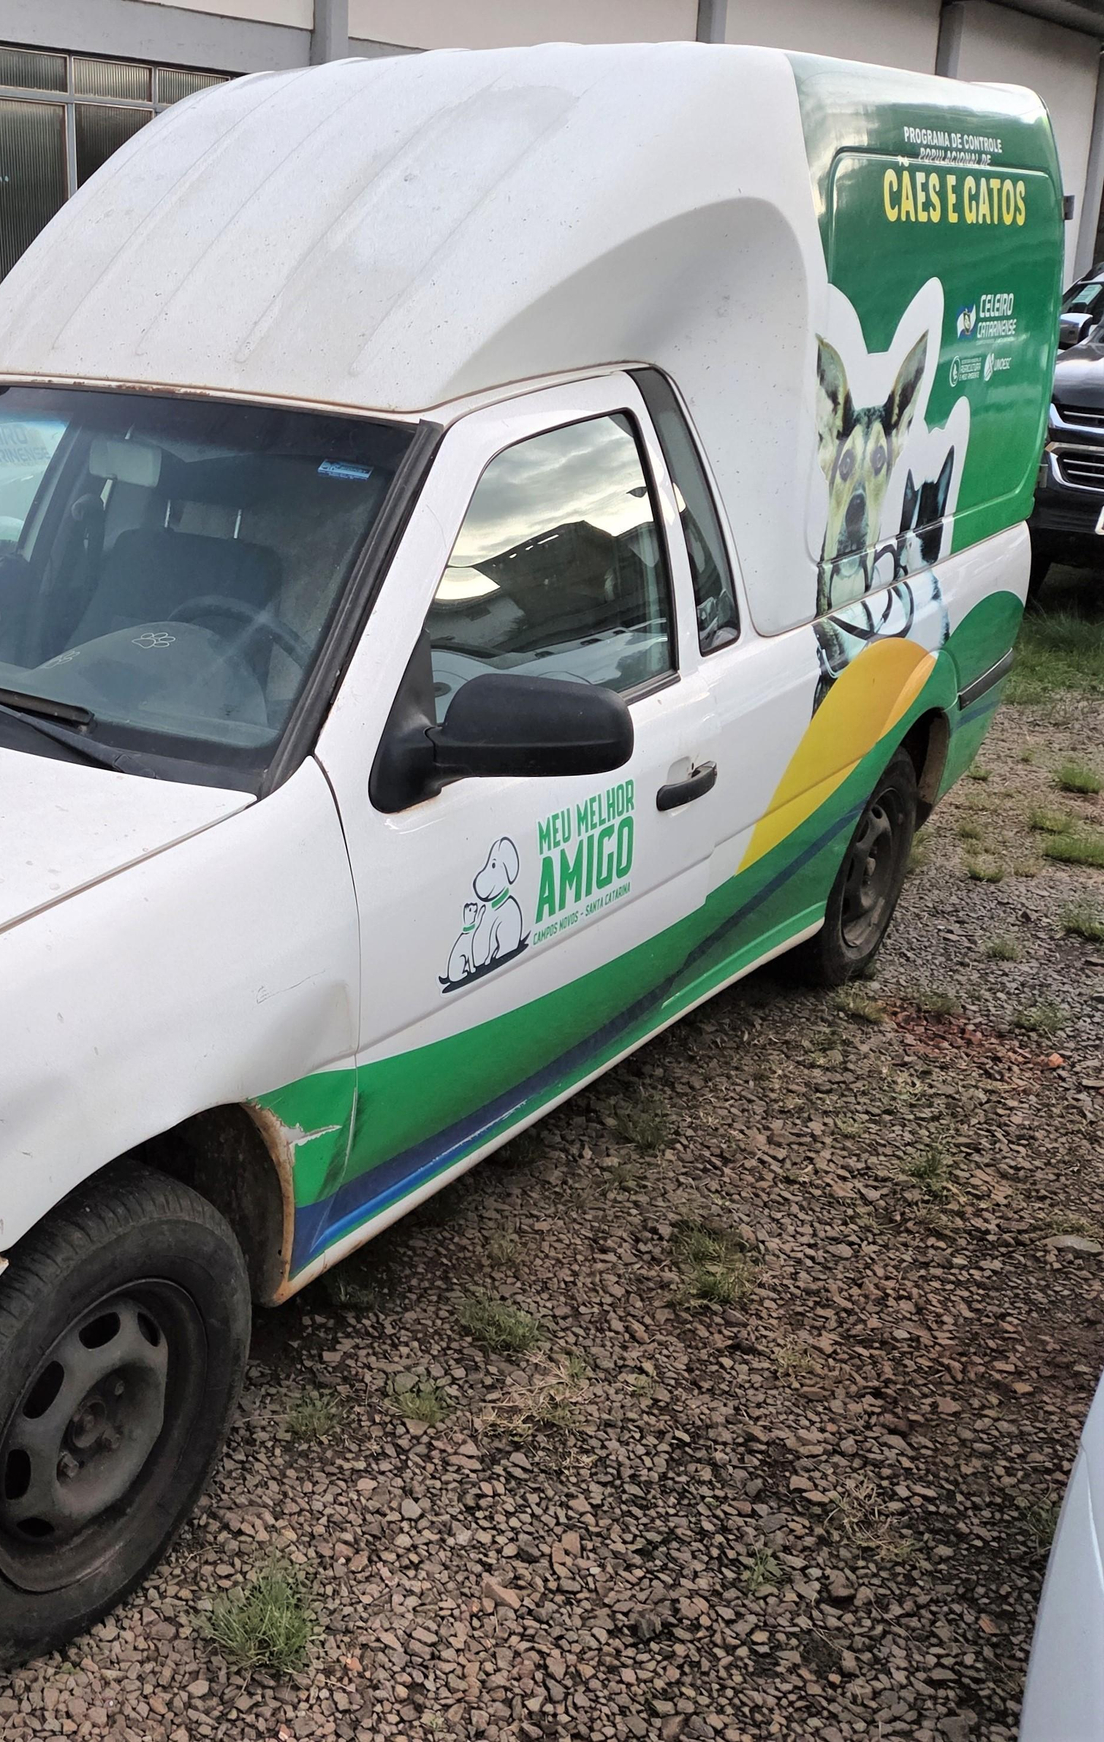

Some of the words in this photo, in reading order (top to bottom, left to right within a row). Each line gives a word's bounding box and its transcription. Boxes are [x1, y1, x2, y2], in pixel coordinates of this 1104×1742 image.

[904, 126, 949, 147] PROGRAMA
[951, 132, 962, 149] DE
[963, 135, 1003, 153] CONTROLE
[883, 155, 942, 223] CÃES
[947, 174, 959, 223] E
[963, 175, 1026, 226] GATOS
[977, 318, 1017, 338] CATARINENSE
[979, 293, 1014, 318] CELEIRO
[537, 808, 572, 855] MEU
[576, 779, 635, 837] MELHOR
[535, 815, 635, 924] AMIGO
[533, 921, 558, 945] CAMPOS
[559, 910, 579, 932] NOVOS
[585, 896, 604, 917] SANTA
[604, 881, 631, 909] CATARINA
